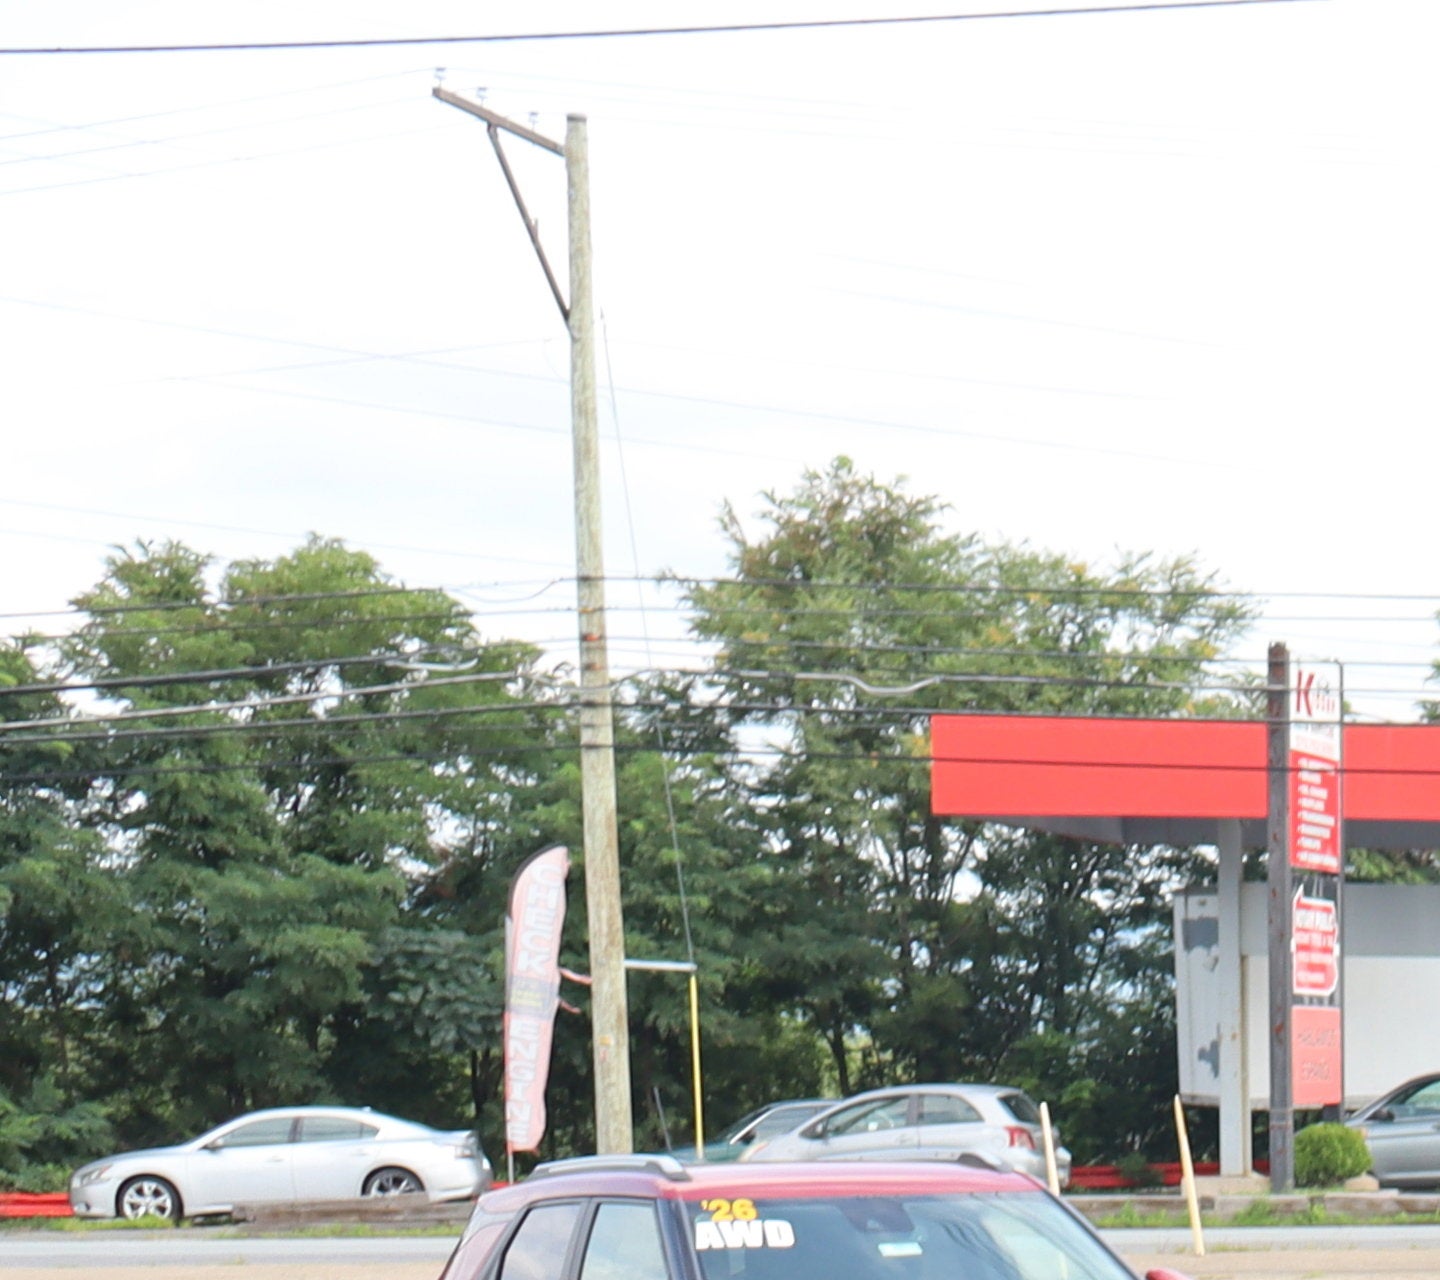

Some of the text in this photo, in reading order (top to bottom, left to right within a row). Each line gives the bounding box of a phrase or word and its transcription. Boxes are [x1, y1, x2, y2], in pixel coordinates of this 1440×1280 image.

[516, 862, 562, 976] CHECK
[506, 1018, 541, 1144] ENGINE
[695, 1219, 795, 1250] AWD
